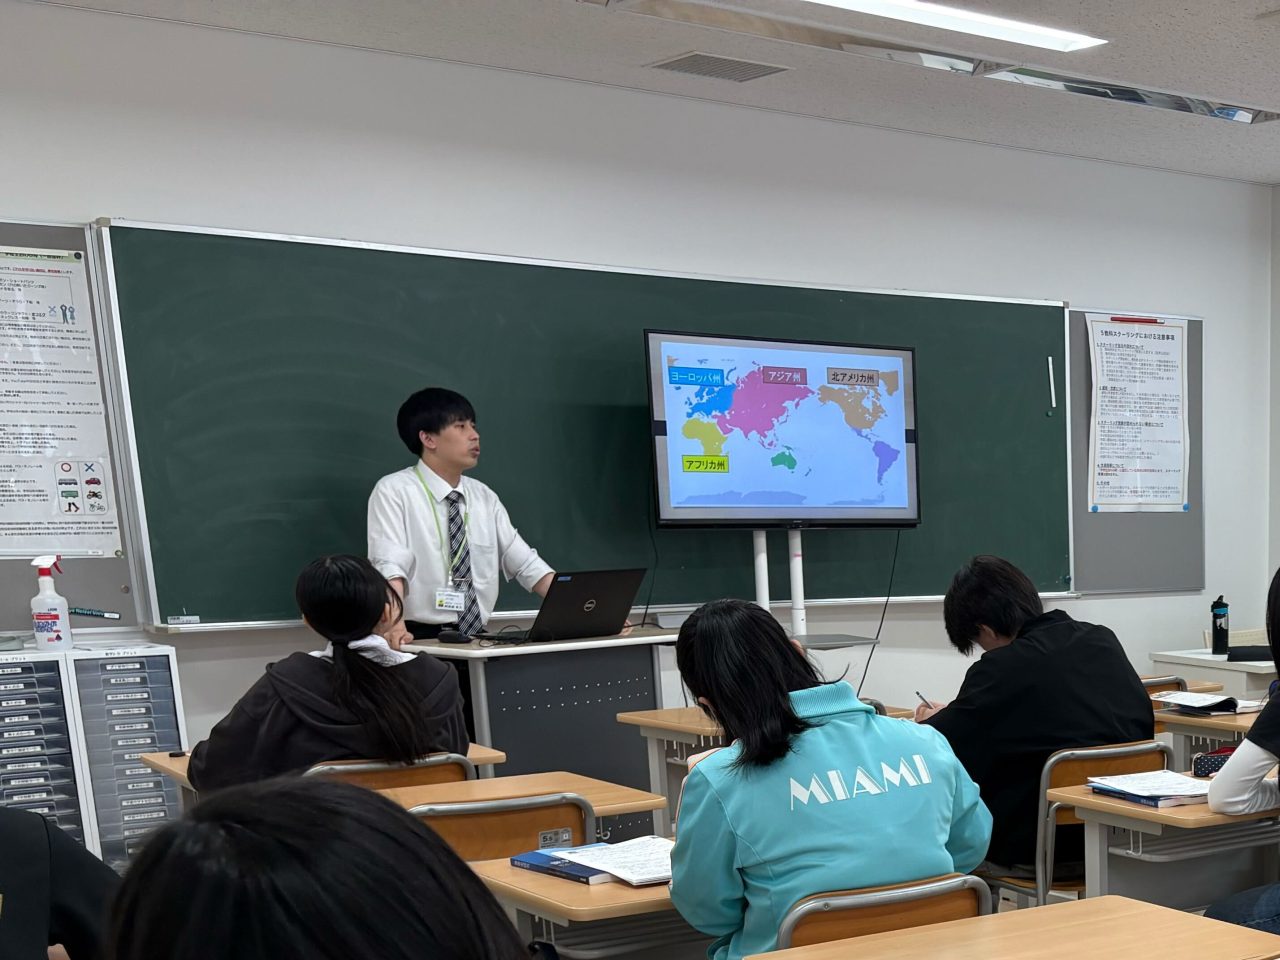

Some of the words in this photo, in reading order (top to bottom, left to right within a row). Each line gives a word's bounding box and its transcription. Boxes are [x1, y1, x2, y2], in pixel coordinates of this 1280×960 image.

[671, 371, 722, 384] ヨーロッパ州
[768, 371, 801, 382] アジア州
[831, 371, 875, 383] 北アメリカ州
[685, 460, 726, 471] アフリカ州
[789, 754, 932, 811] MIAMI
